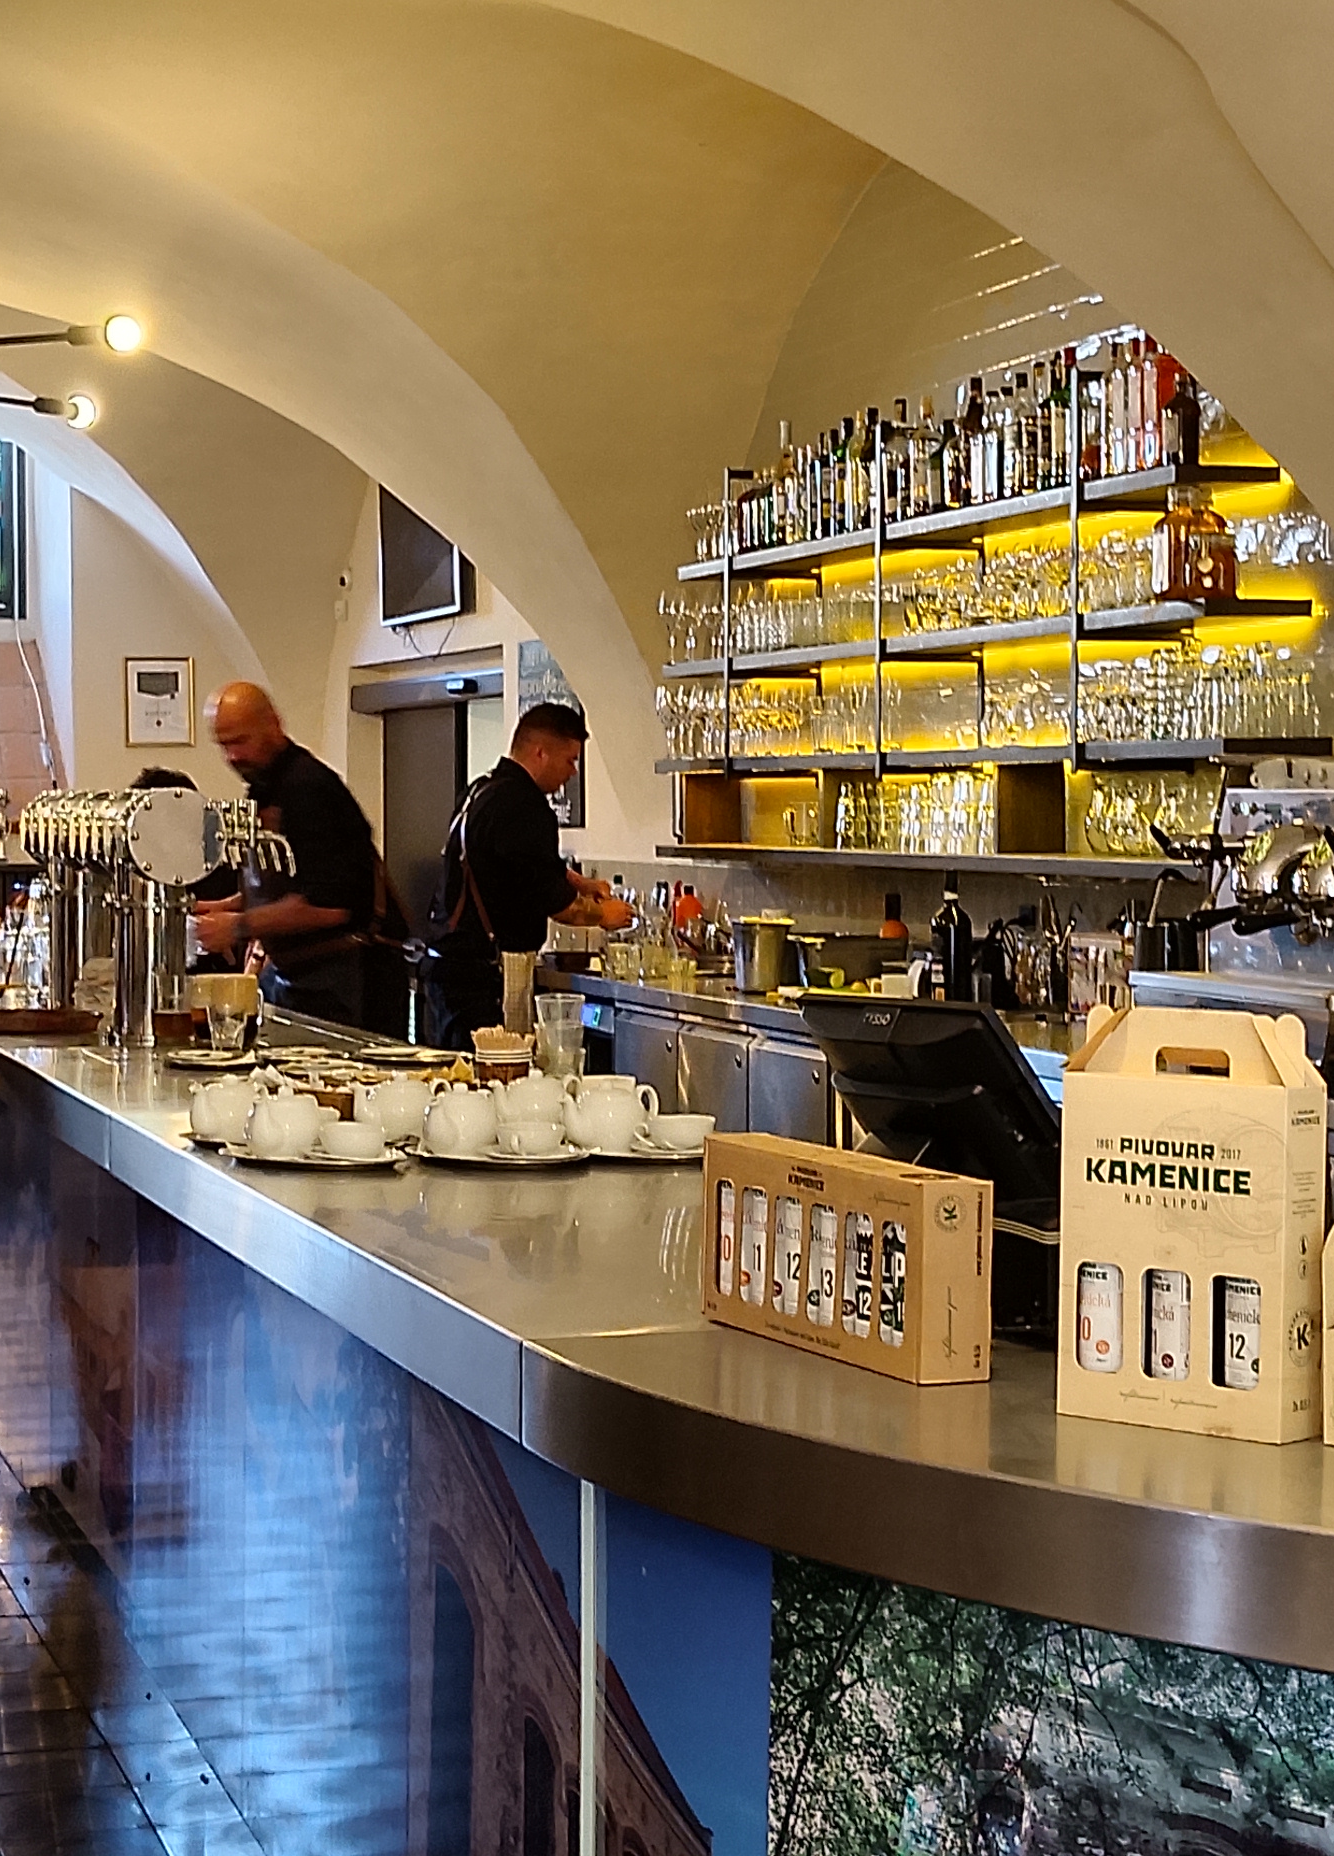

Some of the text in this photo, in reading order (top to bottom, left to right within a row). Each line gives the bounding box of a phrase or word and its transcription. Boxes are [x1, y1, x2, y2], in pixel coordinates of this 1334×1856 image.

[1119, 1137, 1216, 1161] PIVOVAR
[1220, 1148, 1241, 1160] 2017
[1085, 1157, 1252, 1196] KAMENICE
[941, 1204, 958, 1221] K
[1124, 1193, 1209, 1212] NAD LIPOU
[753, 1243, 762, 1272] 11
[787, 1252, 802, 1281] 12
[820, 1267, 834, 1298] 13
[858, 1291, 872, 1316] 12
[1229, 1333, 1246, 1360] 12
[1296, 1323, 1310, 1350] K
